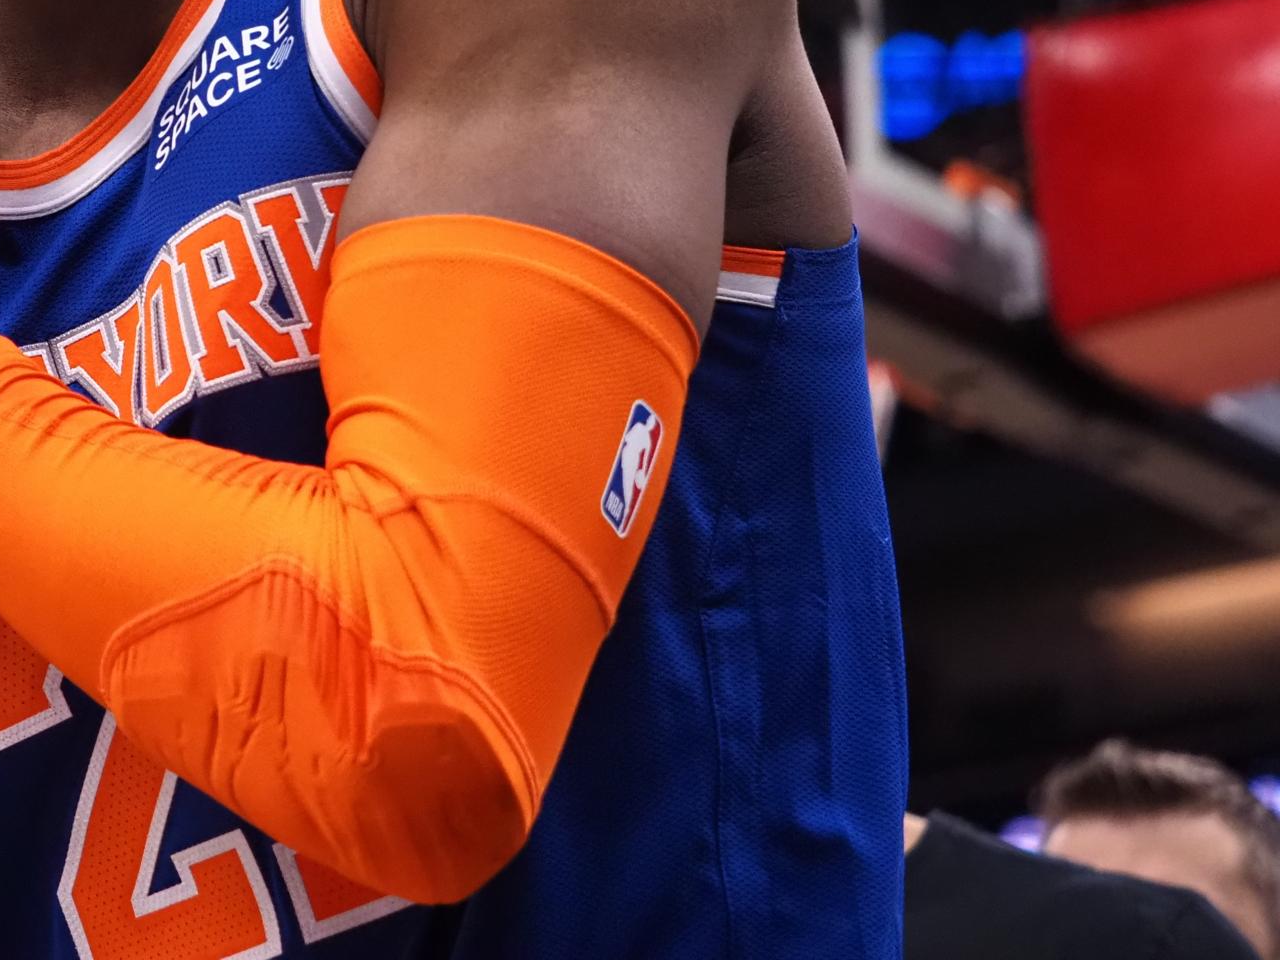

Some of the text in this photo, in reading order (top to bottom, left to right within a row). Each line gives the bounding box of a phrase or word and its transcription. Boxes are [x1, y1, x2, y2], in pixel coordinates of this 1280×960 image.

[154, 59, 262, 170] SPACE
[158, 6, 289, 138] SQUARE
[605, 491, 624, 520] NBA
